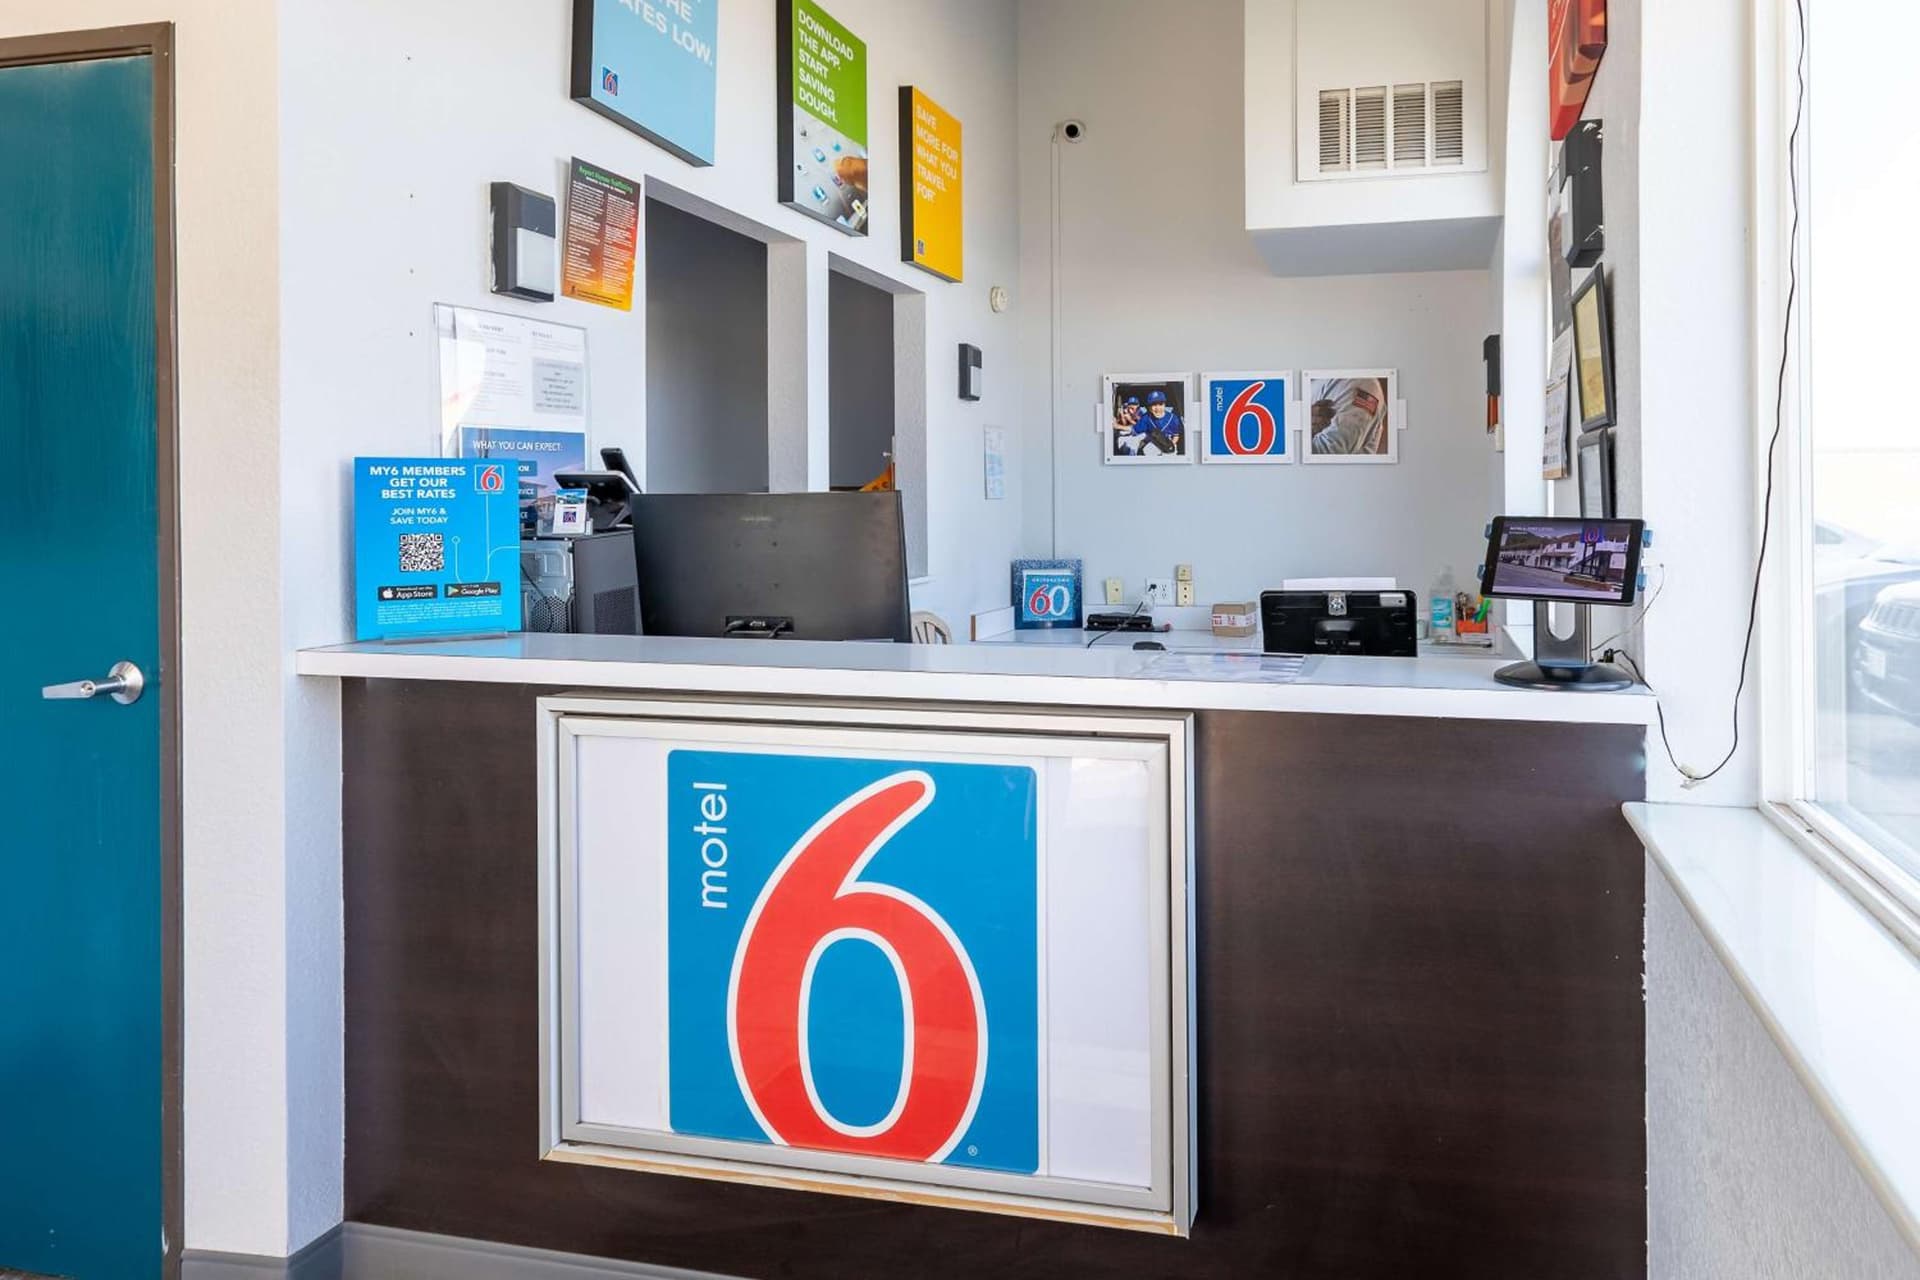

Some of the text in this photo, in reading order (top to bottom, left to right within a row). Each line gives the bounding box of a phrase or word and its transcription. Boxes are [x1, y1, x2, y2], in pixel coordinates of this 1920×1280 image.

[663, 0, 693, 24] HE
[673, 23, 712, 67] LOW.
[799, 8, 854, 61] DOWNLOAD
[799, 28, 841, 70] THE APP.
[799, 48, 829, 79] START
[799, 67, 836, 102] SAVING
[799, 87, 839, 123] DOUGH.
[916, 104, 937, 129] SAVE
[916, 124, 958, 162] MORE FOR
[916, 144, 958, 180] WHAT YOU
[917, 163, 947, 192] TRAVEL
[1215, 387, 1224, 412] motel
[1223, 381, 1277, 456] 6
[472, 440, 497, 450] WHAT
[499, 440, 515, 450] YOU
[517, 441, 533, 451] CAN
[370, 466, 466, 476] MY6 MEMBERS
[389, 478, 448, 487] GET OUR
[480, 465, 503, 491] 6
[381, 489, 456, 499] BEST RATES
[390, 517, 448, 525] SAVE TODAY
[392, 508, 415, 516] JOIN
[396, 591, 412, 599] App
[460, 587, 498, 596] Google Play
[1029, 584, 1070, 617] 60
[692, 781, 729, 910] motel
[727, 769, 989, 1164] 6
